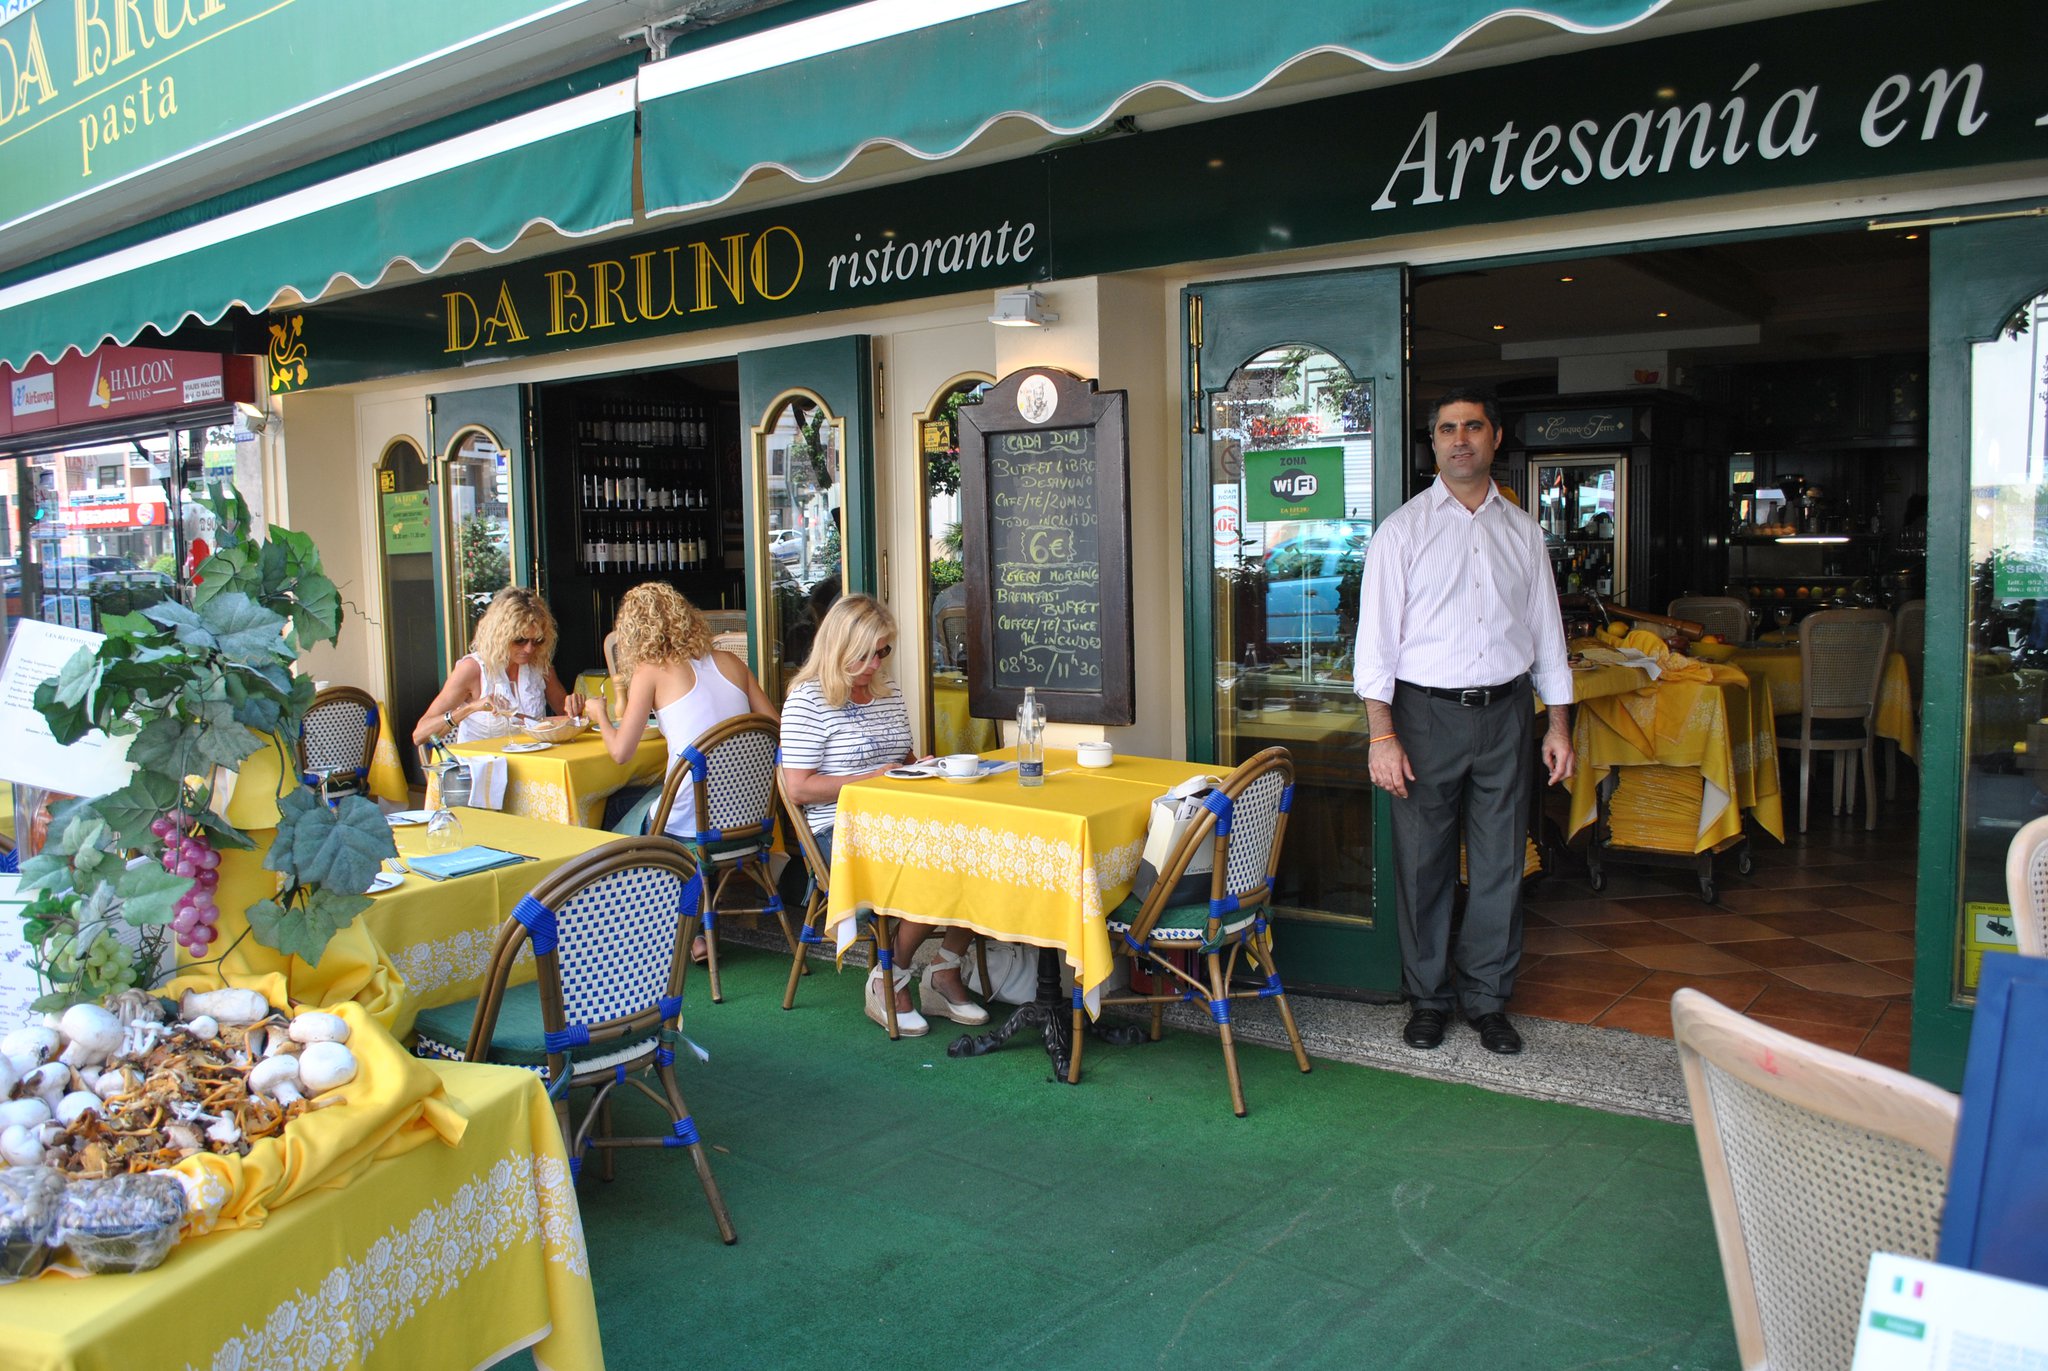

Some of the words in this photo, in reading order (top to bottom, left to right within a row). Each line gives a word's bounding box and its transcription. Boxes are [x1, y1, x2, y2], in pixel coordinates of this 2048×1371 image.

[79, 75, 179, 177] pasta
[1371, 63, 1819, 211] Artesanía
[1860, 63, 1989, 149] en
[442, 279, 530, 353] DA
[545, 226, 804, 337] BRUNO
[828, 220, 1036, 291] ristorante
[110, 358, 175, 392] HALCON
[124, 389, 151, 401] VIAJES
[1545, 416, 1581, 441] Cinque
[1580, 414, 1616, 439] Terre
[1006, 434, 1042, 451] CADA
[992, 458, 1053, 477] BUFFET
[1280, 456, 1307, 467] ZONA
[1020, 475, 1093, 490] DESAYUNO
[995, 516, 1030, 528] TODO
[1029, 531, 1066, 564] 6€
[1006, 569, 1041, 583] EVERY
[1050, 566, 1099, 582] MORNING
[996, 587, 1063, 604] BREAKFAST
[1039, 600, 1100, 617] BUFFET
